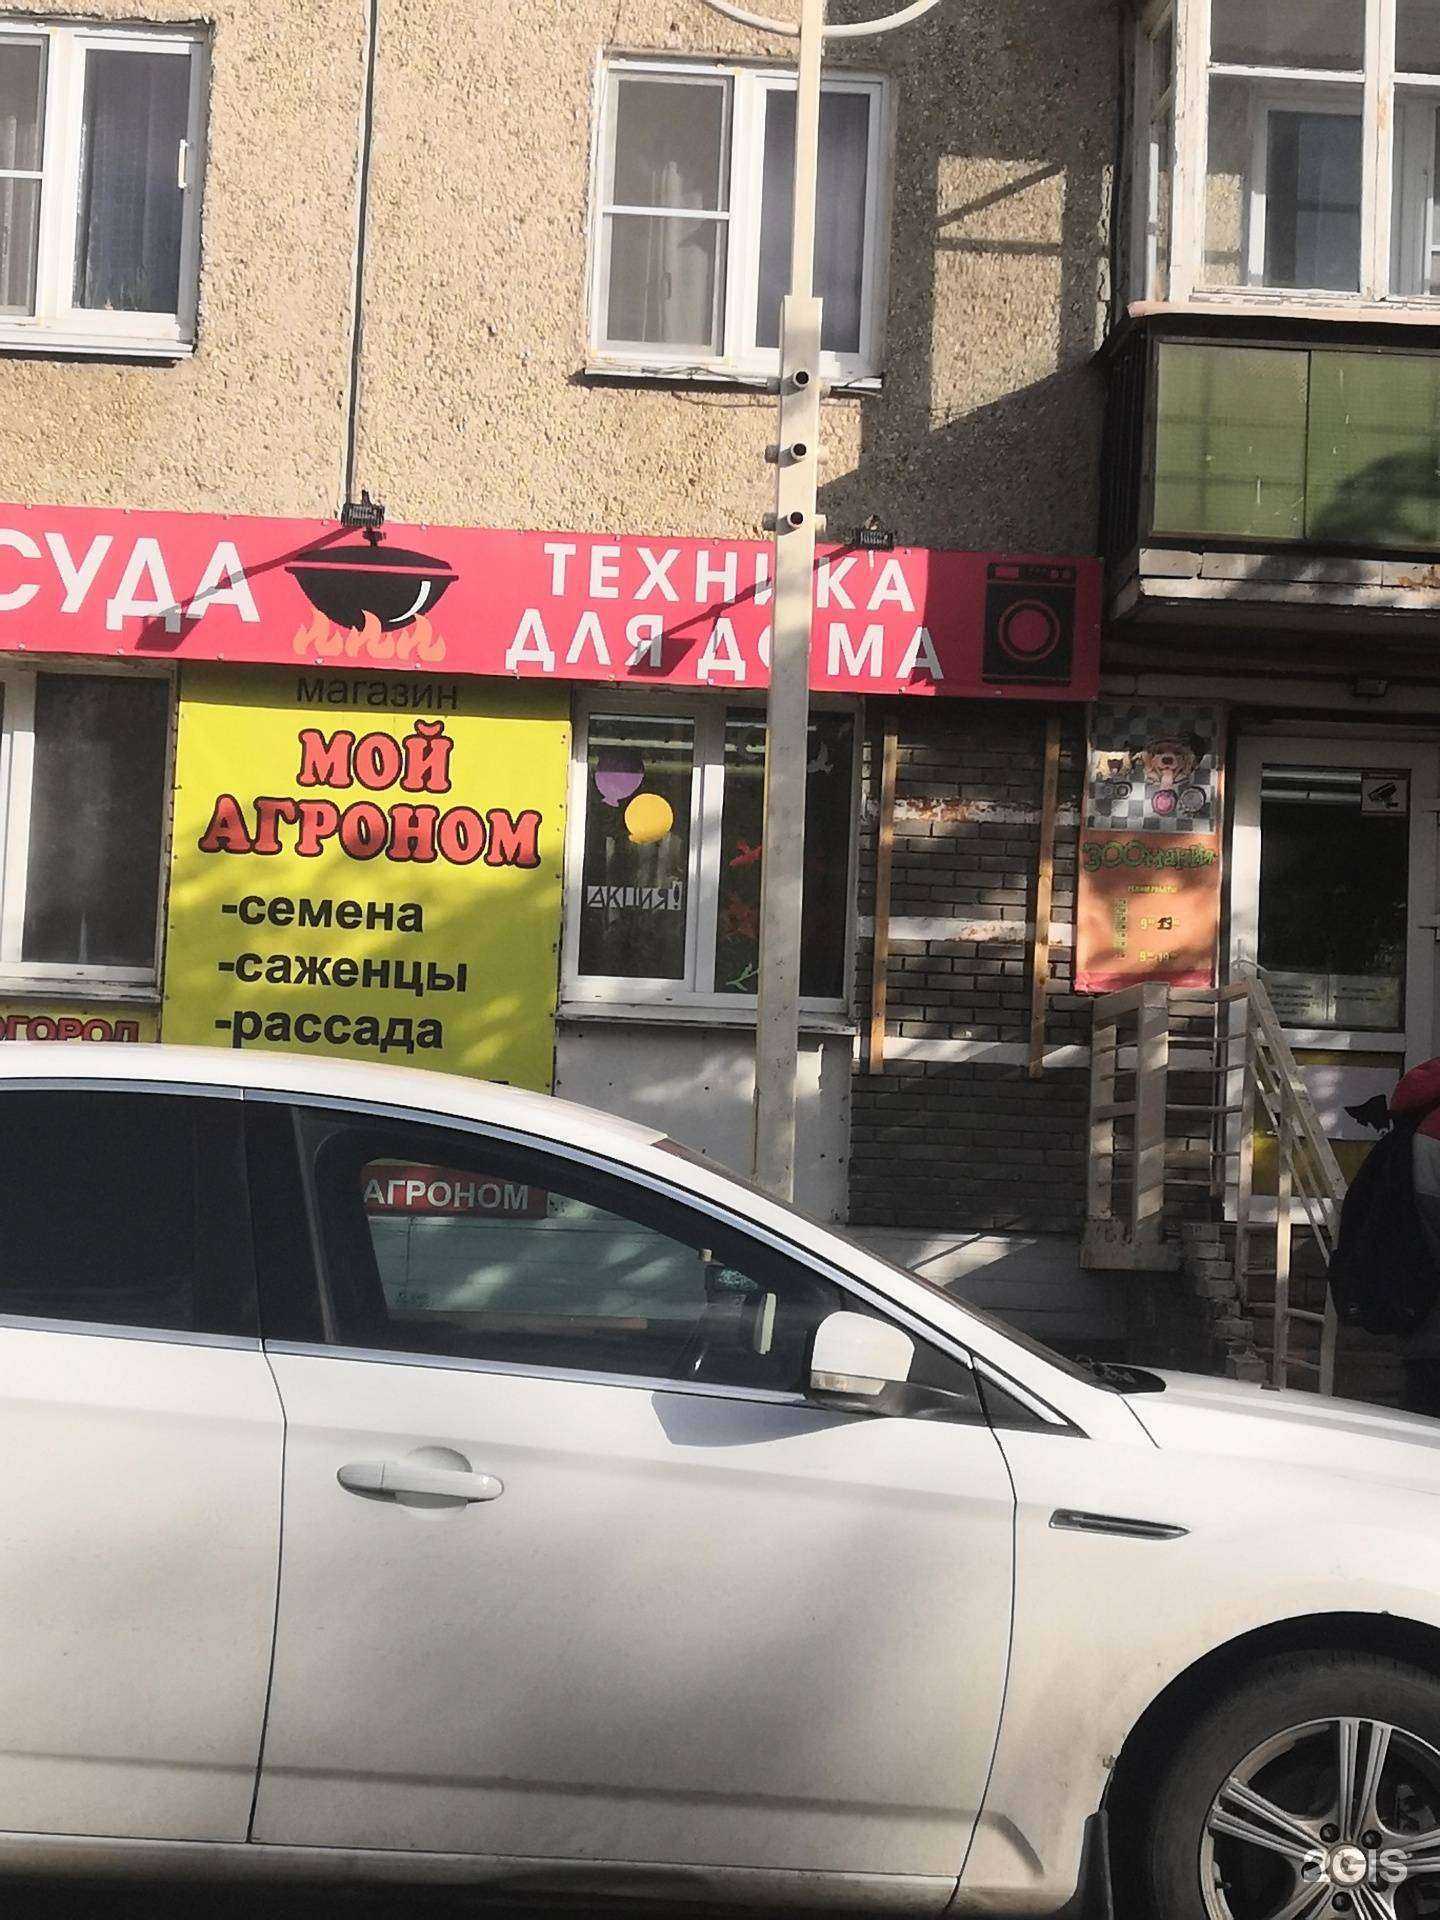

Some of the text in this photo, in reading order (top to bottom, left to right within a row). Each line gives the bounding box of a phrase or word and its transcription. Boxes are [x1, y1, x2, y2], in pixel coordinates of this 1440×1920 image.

[0, 528, 261, 633] СУДА
[505, 609, 945, 682] ДЛЯ ДМА
[296, 677, 459, 710] магазин
[296, 719, 455, 794] МОЙ
[199, 795, 542, 869] АГРОНОМ
[221, 895, 424, 933] -семена
[587, 882, 683, 910] АКЦИЯ!
[218, 952, 469, 997] -саженцы
[214, 1010, 443, 1050] -рассада
[363, 1178, 529, 1210] АГРОНОМ
